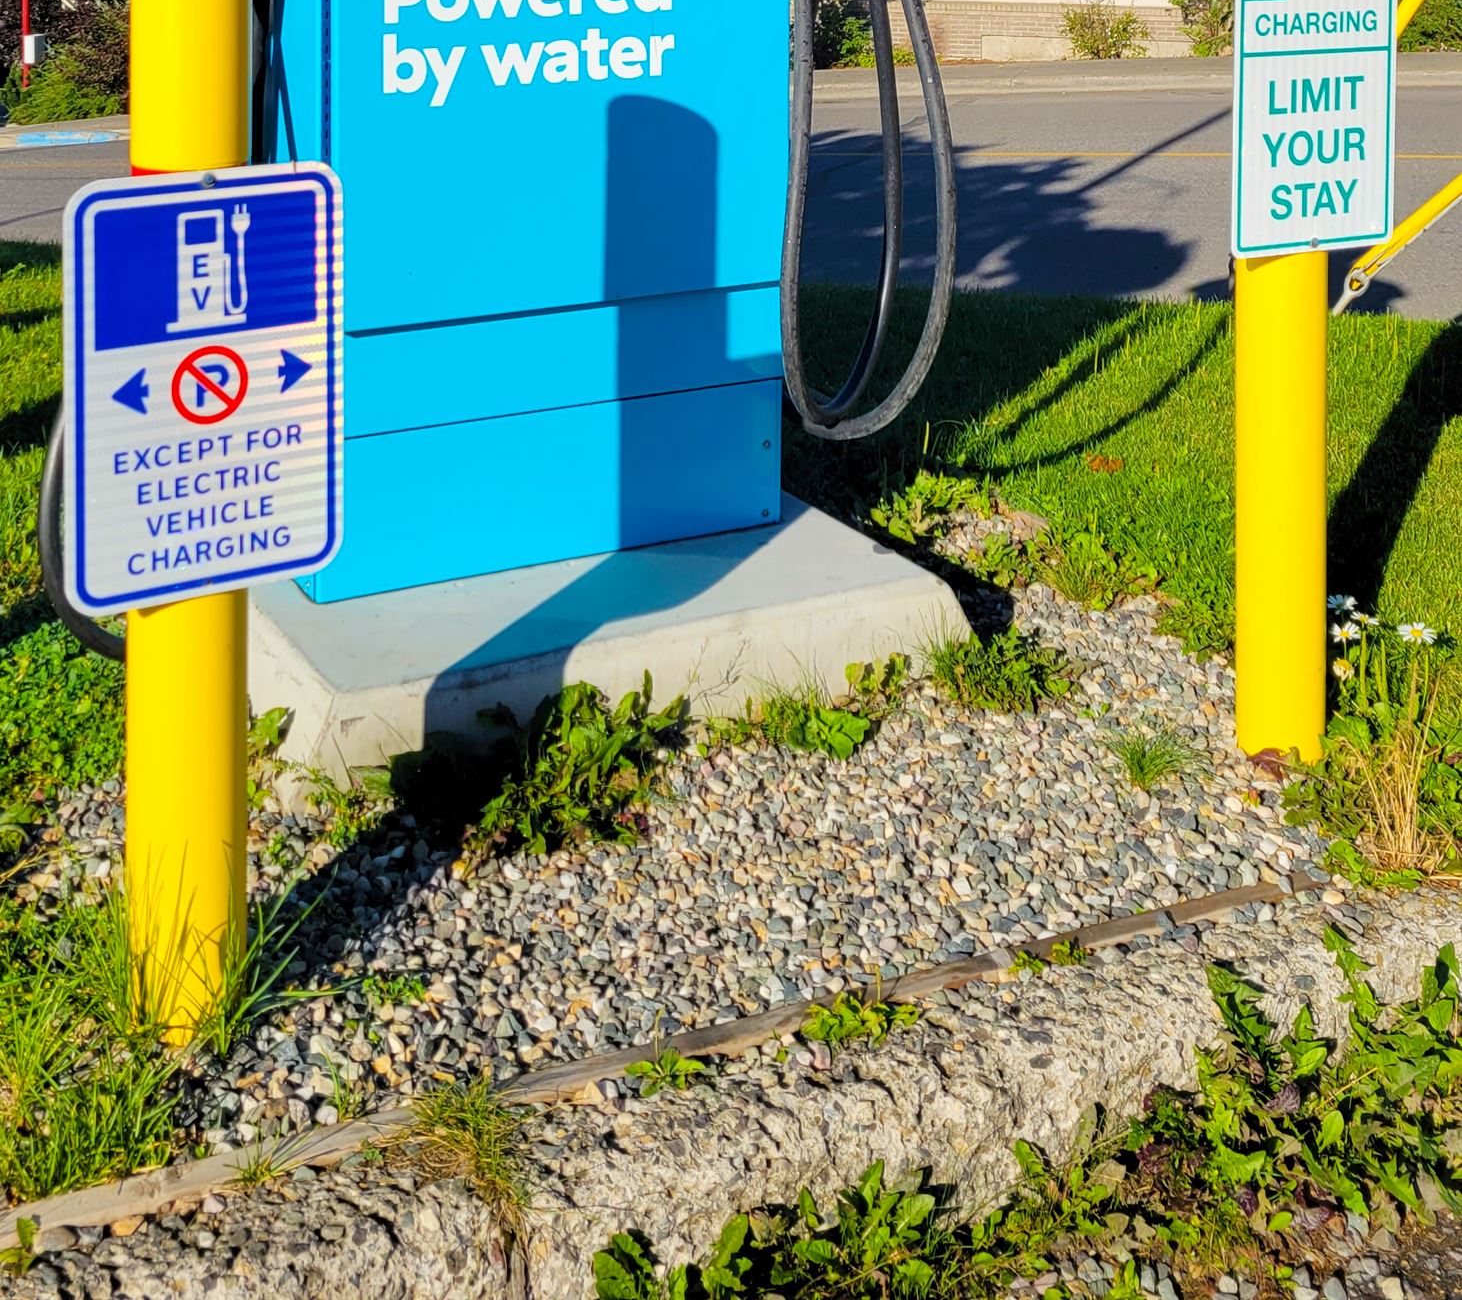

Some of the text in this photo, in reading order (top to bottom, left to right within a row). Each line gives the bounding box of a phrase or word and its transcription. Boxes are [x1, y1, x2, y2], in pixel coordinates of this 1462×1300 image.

[1255, 10, 1378, 36] CHARGING
[383, 27, 675, 107] by water
[1269, 75, 1364, 115] LIMIT
[1263, 127, 1365, 167] YOUR
[1270, 179, 1358, 221] STAY
[113, 423, 302, 475] EXCEPT FOR
[137, 460, 282, 505] ELECTRIC
[146, 495, 275, 537] VEHICLE
[127, 526, 292, 576] CHARGING
